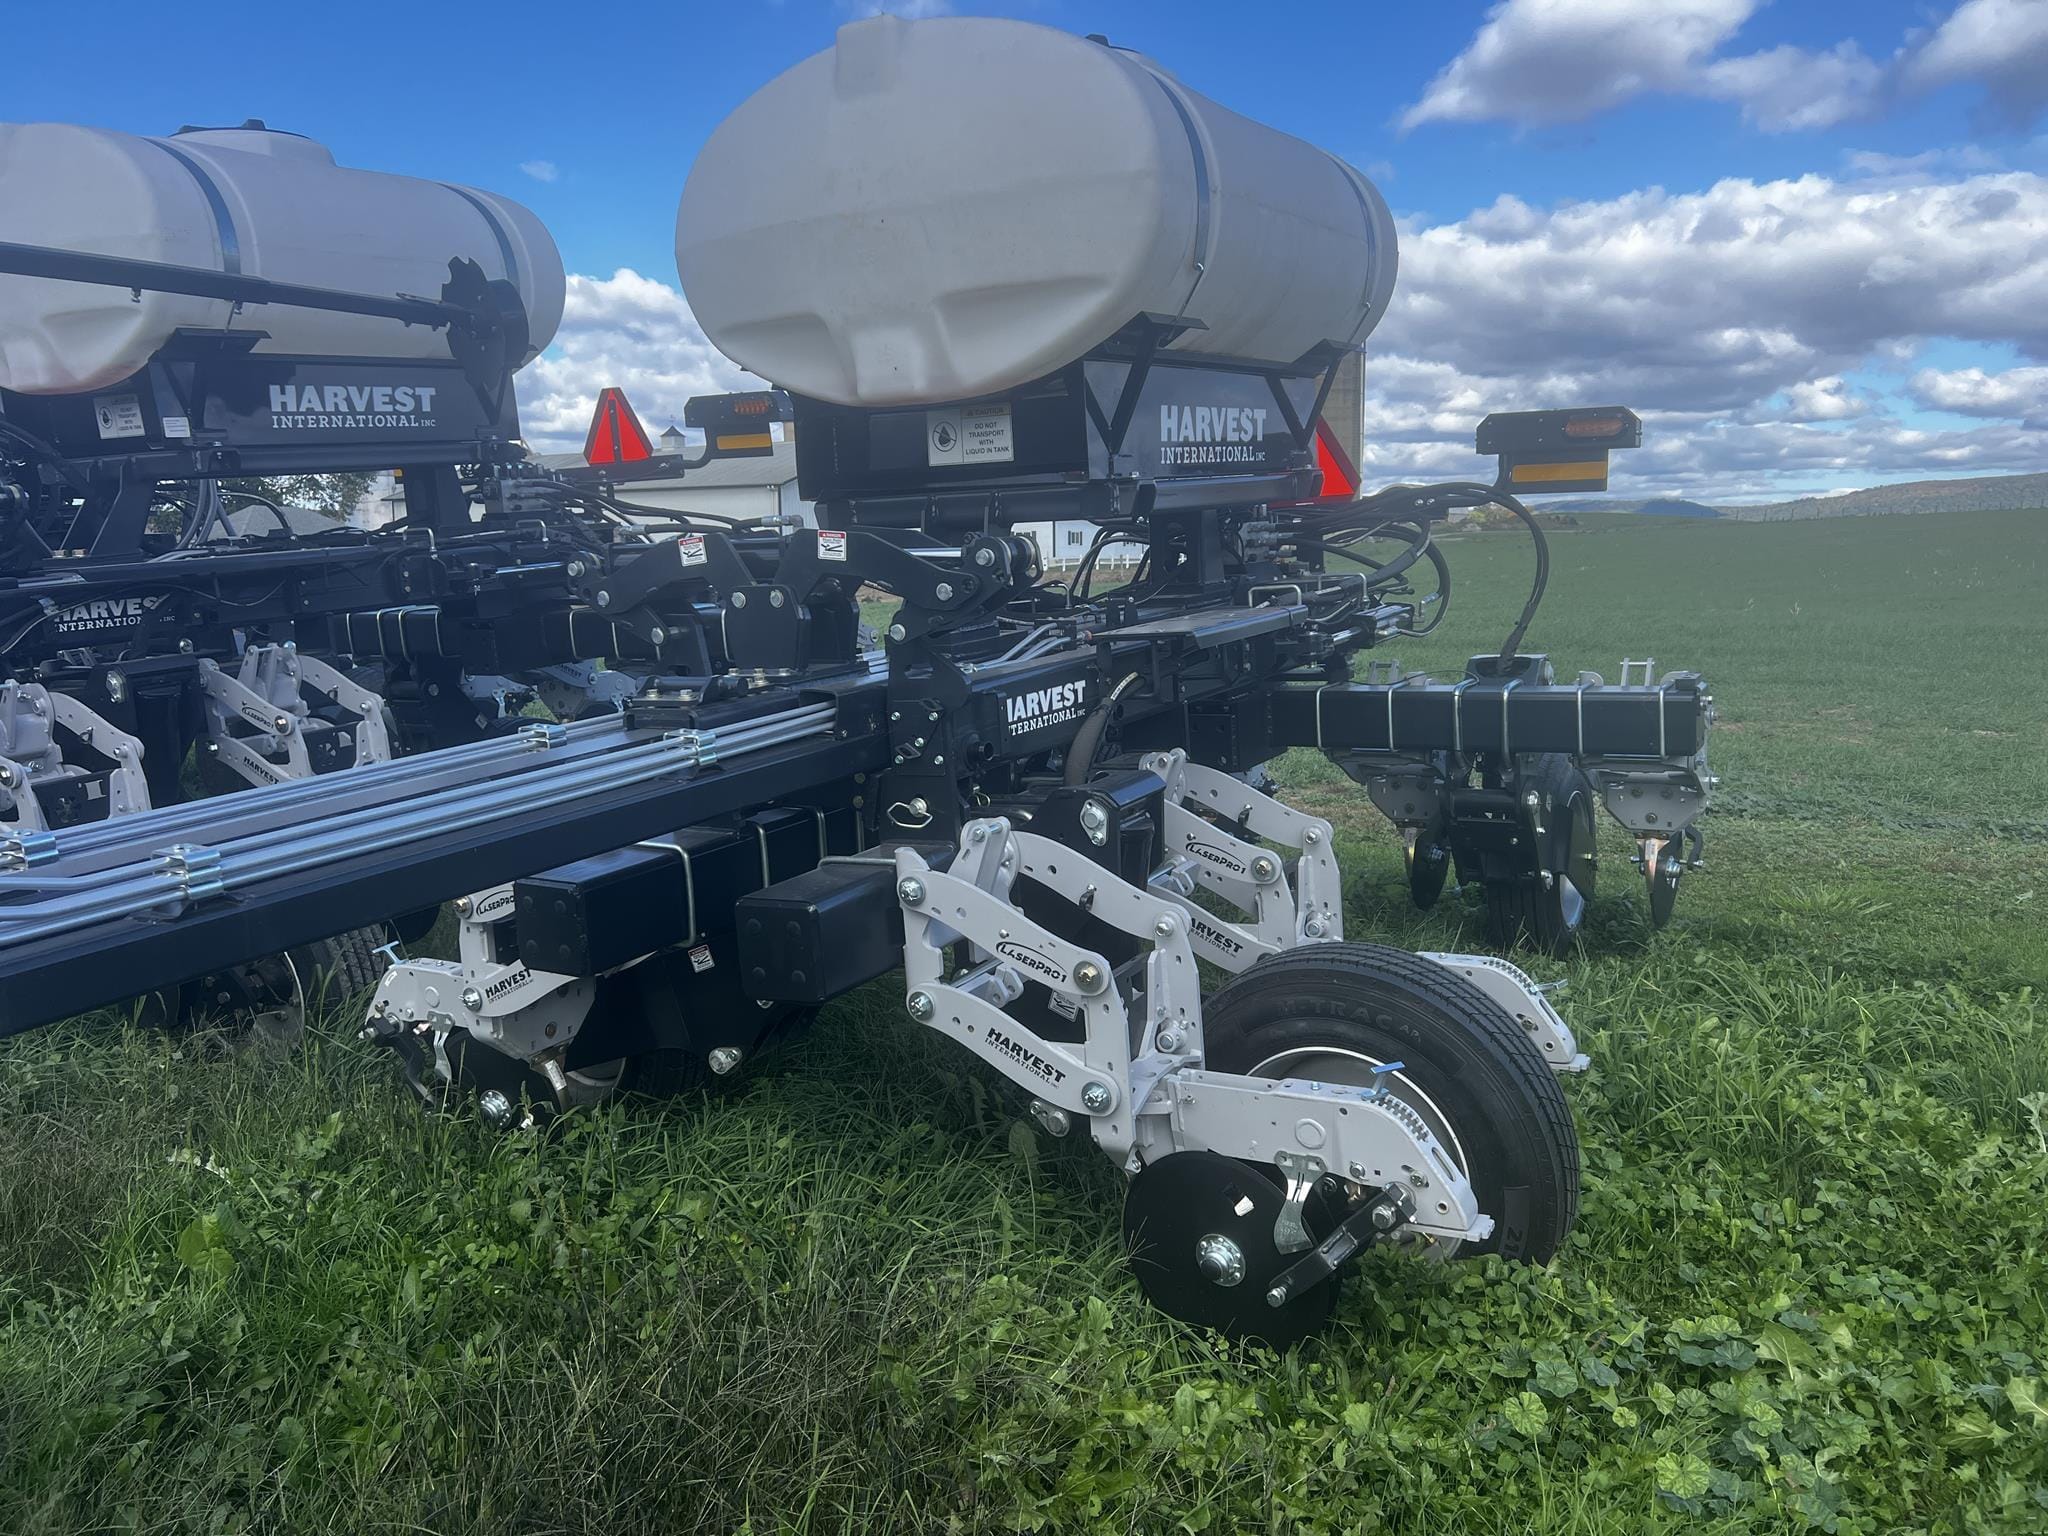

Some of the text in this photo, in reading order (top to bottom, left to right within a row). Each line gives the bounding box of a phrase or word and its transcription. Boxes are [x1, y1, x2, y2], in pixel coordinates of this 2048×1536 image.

[269, 384, 436, 412] HARVEST
[272, 415, 418, 428] INTERNATIONAL
[969, 430, 1005, 438] TRANSPORT
[1160, 405, 1267, 442] HARVEST
[1160, 446, 1255, 464] INTERNATIONAL
[1008, 708, 1077, 736] TERNATIONAL
[244, 757, 280, 784] HARVEST
[480, 896, 515, 914] LASERPRO
[485, 968, 531, 999] HARVEST
[984, 1037, 1050, 1084] INTERNATIONAL
[987, 1027, 1066, 1083] HARVEST
